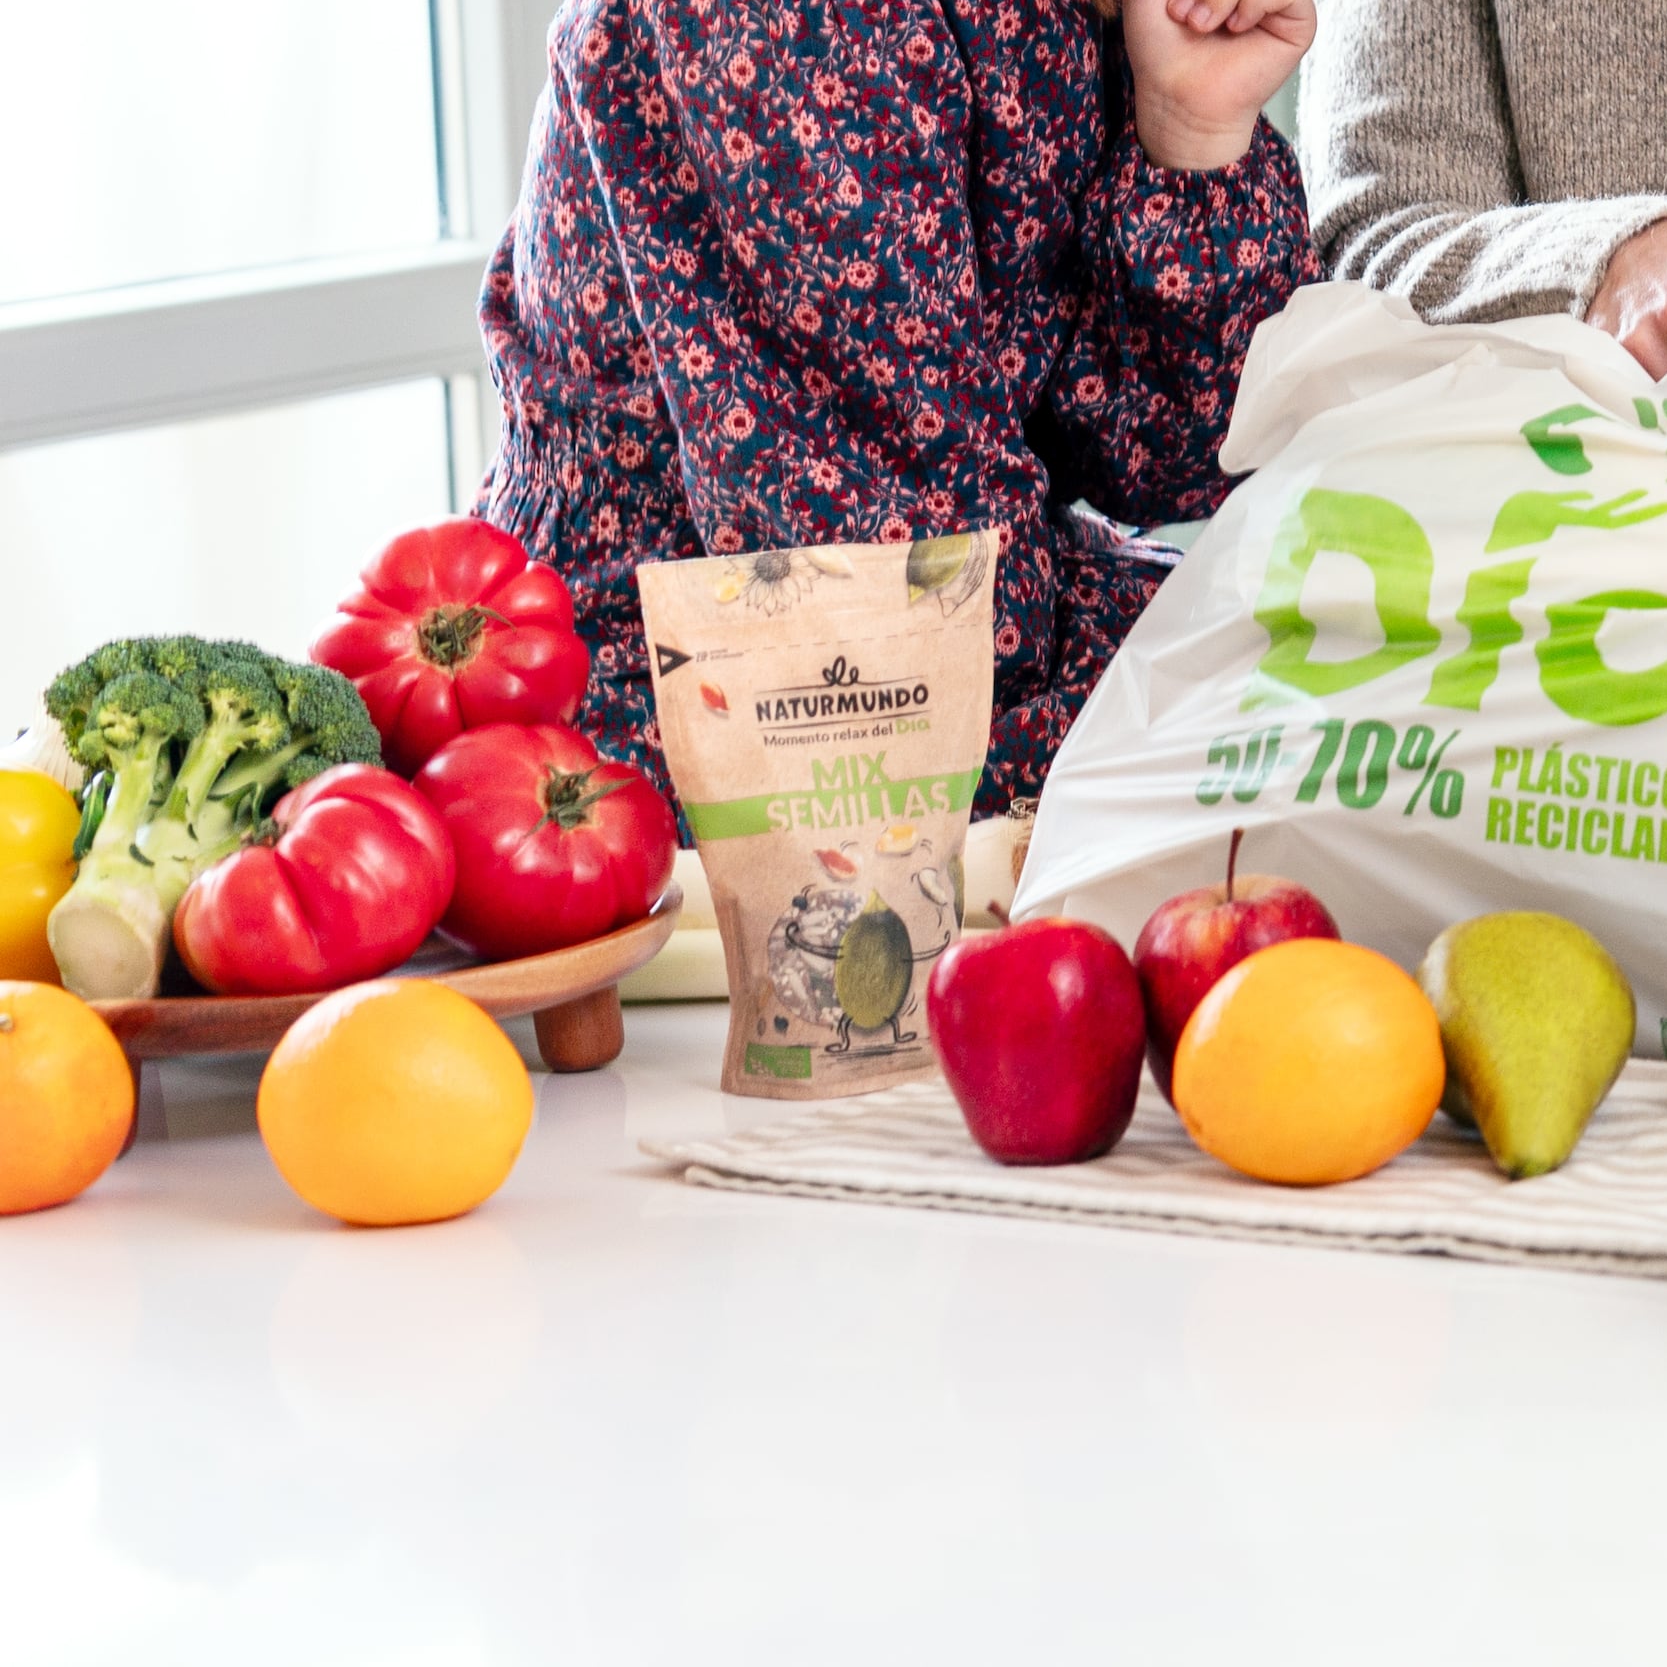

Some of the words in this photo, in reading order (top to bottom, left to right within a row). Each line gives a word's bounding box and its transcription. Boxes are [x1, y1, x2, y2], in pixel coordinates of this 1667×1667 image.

[756, 684, 929, 722] NATURMUNDO
[764, 733, 830, 748] Momento
[833, 728, 868, 741] relax
[872, 723, 893, 735] del
[811, 750, 891, 791] MIX
[1195, 718, 1466, 819] 50-70%
[767, 781, 951, 835] SEMILLAS
